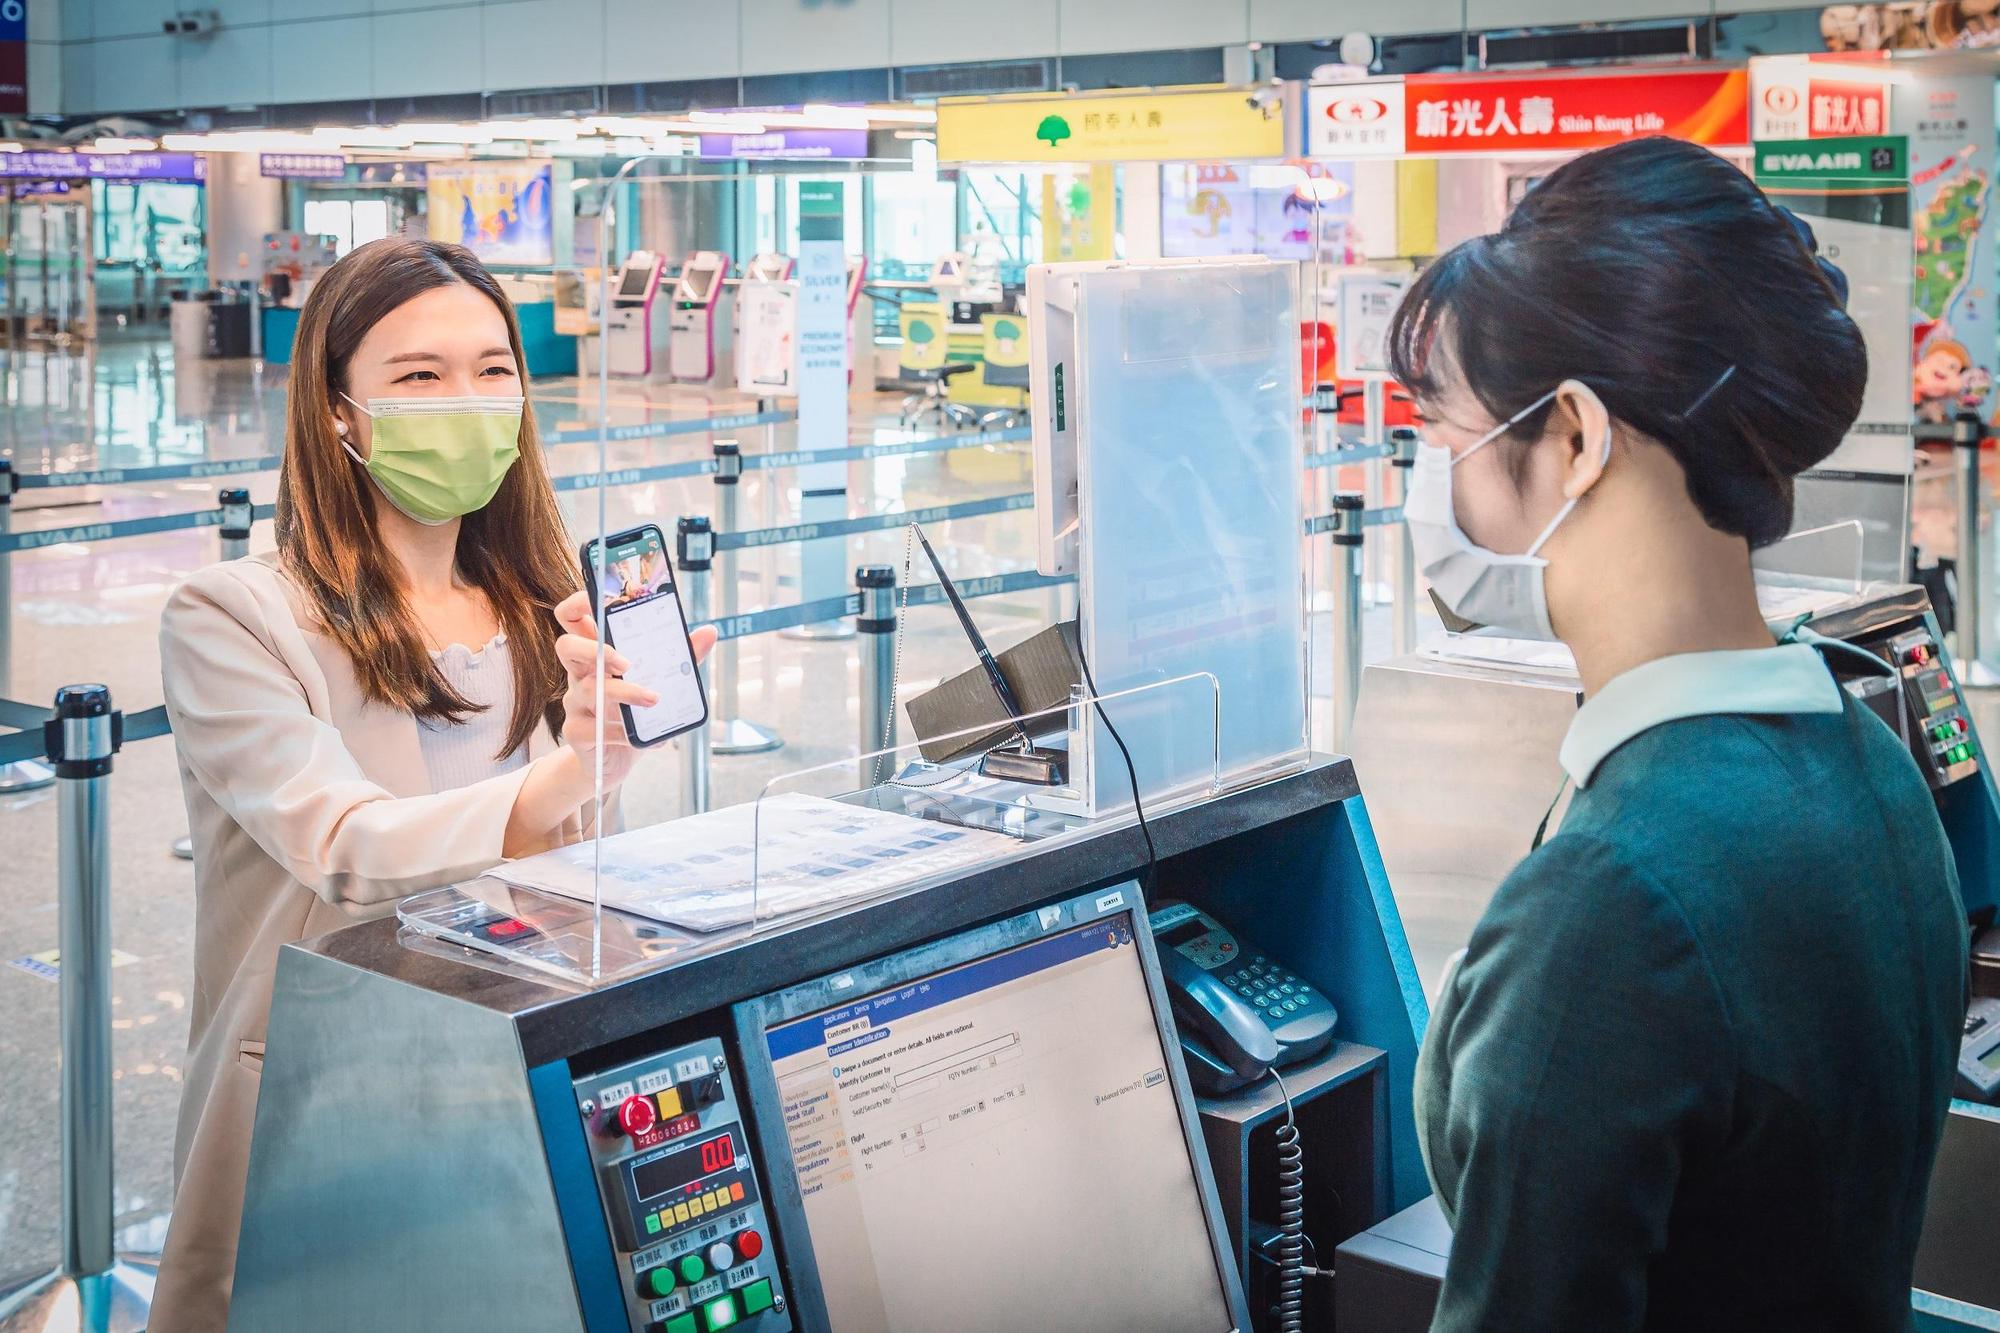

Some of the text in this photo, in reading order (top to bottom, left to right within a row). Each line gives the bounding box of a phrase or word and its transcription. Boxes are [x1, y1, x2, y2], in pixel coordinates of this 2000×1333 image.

[1416, 96, 1664, 137] 新光人壽 Shin Kong Life
[1813, 94, 1880, 134] 新光人壽
[827, 1027, 851, 1039] Customer
[828, 1030, 888, 1056] Customer Identification
[861, 1052, 886, 1067] document
[893, 1046, 907, 1056] enter
[932, 1030, 945, 1041] fields
[839, 1066, 891, 1090] Identify Customer by
[849, 1088, 871, 1102] Customer
[785, 1104, 798, 1114] Book
[787, 1112, 800, 1123] Book
[851, 1132, 865, 1145] Flight
[803, 1183, 823, 1196] Restart
